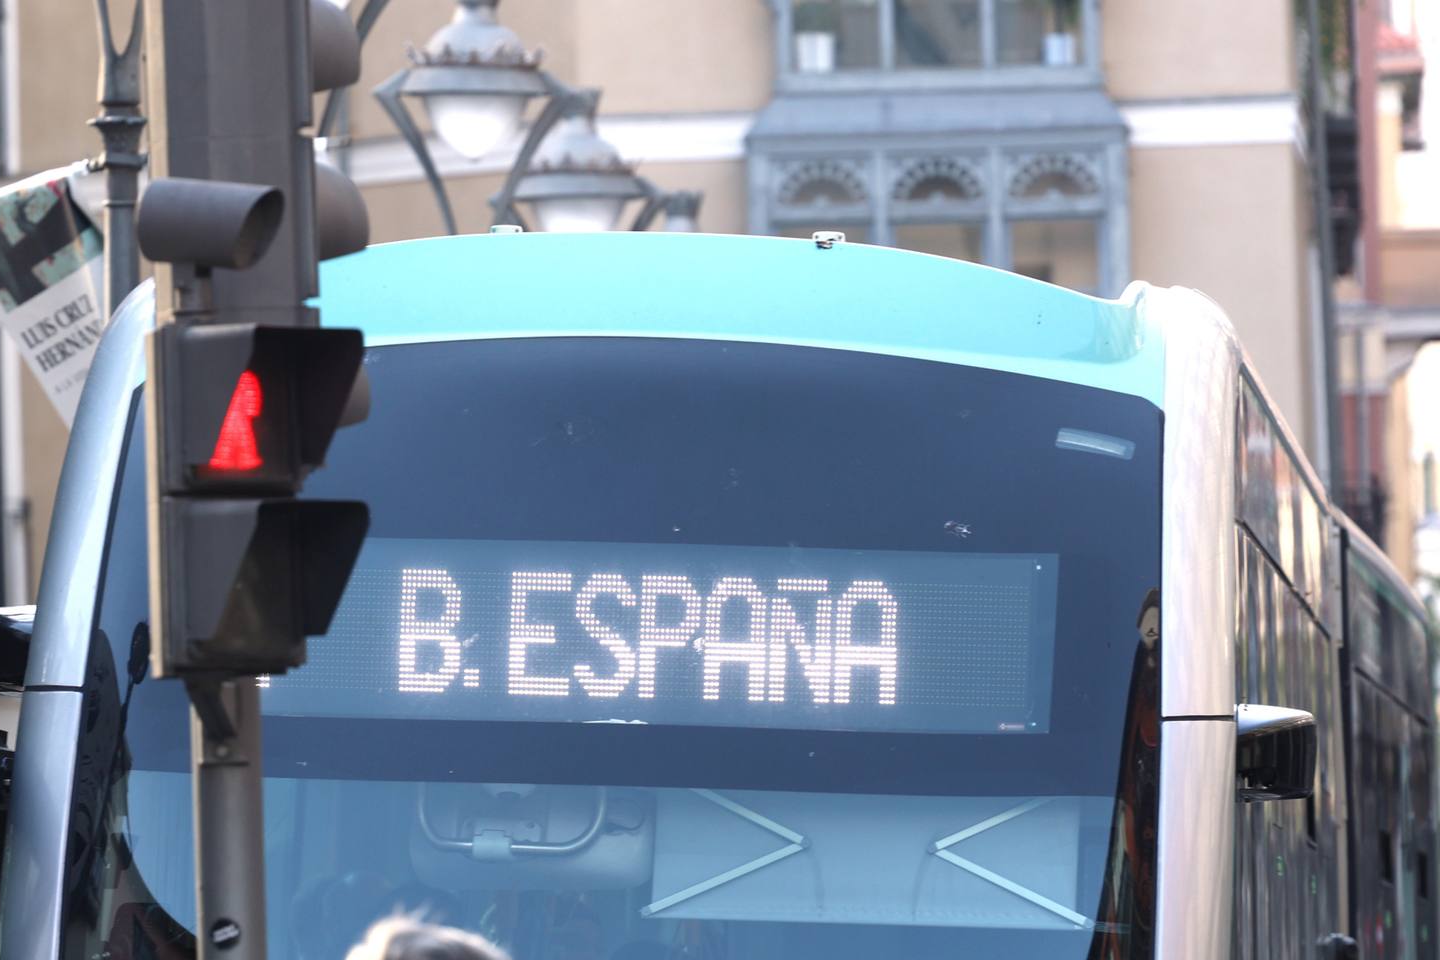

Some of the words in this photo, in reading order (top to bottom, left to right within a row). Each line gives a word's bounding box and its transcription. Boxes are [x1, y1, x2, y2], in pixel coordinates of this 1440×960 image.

[21, 318, 57, 349] LUIS
[54, 294, 93, 328] CRUZ
[399, 569, 479, 692] B.
[509, 571, 898, 705] ESPAÑA
